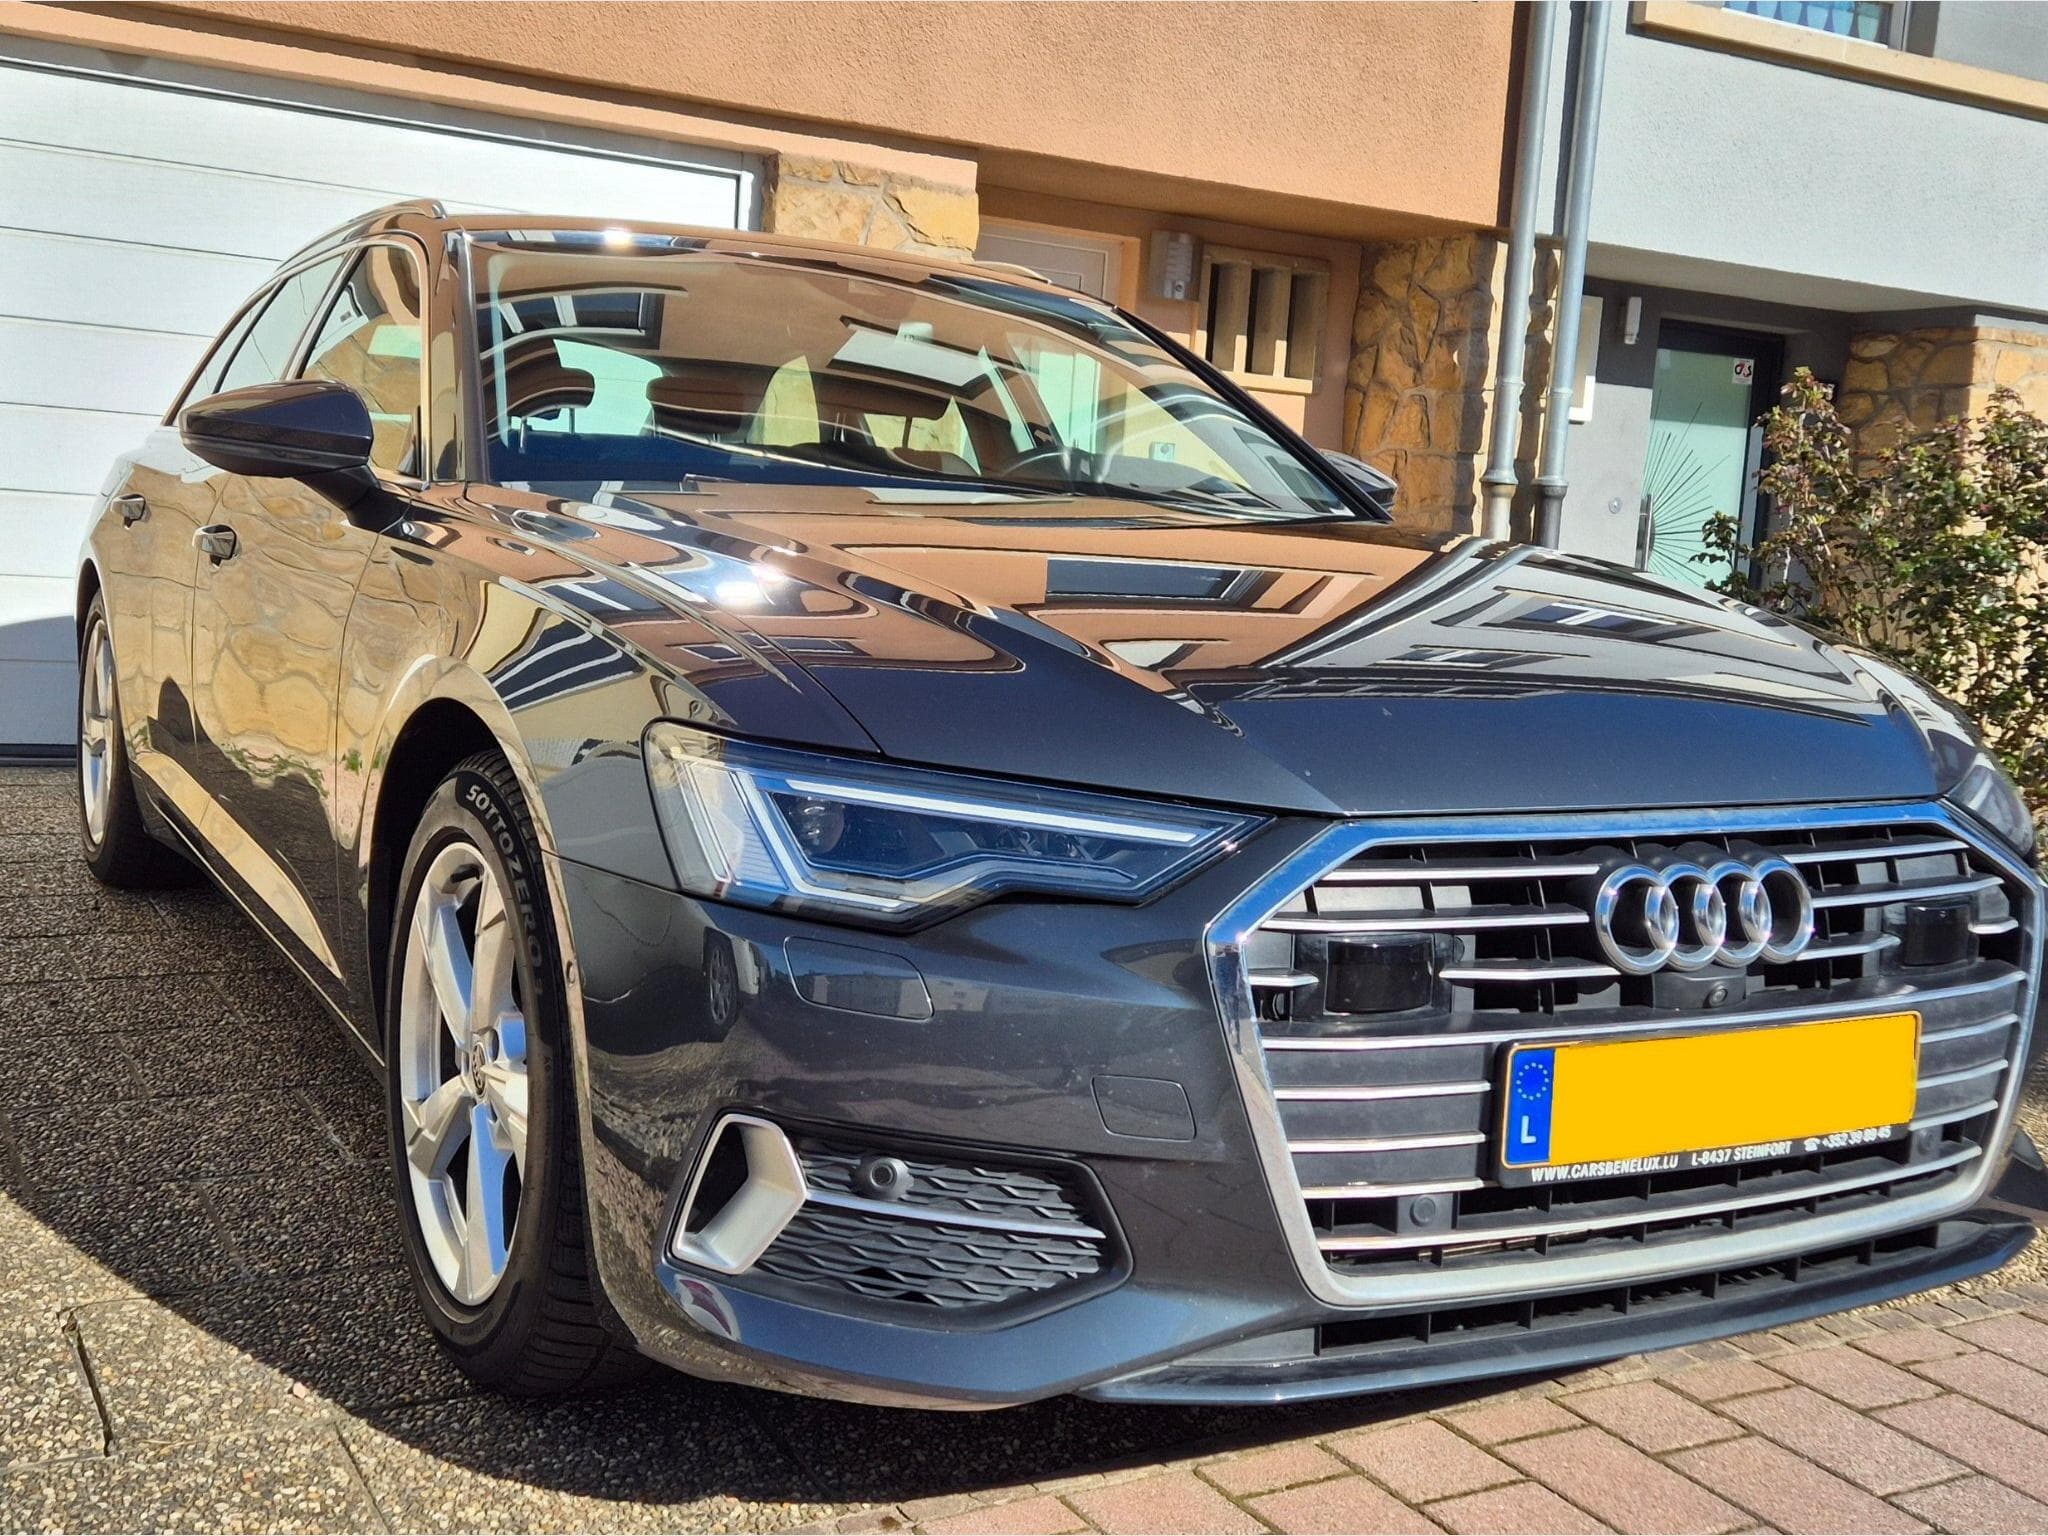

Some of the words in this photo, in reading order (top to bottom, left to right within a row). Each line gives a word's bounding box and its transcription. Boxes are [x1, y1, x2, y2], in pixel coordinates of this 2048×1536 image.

[465, 784, 543, 967] SOTTOZERO
[1520, 1115, 1537, 1144] L
[1531, 1154, 1679, 1182] WWW.CARSBENELUX.LU
[1691, 1146, 1731, 1167] L-8437
[1733, 1140, 1793, 1162] STEINFORT
